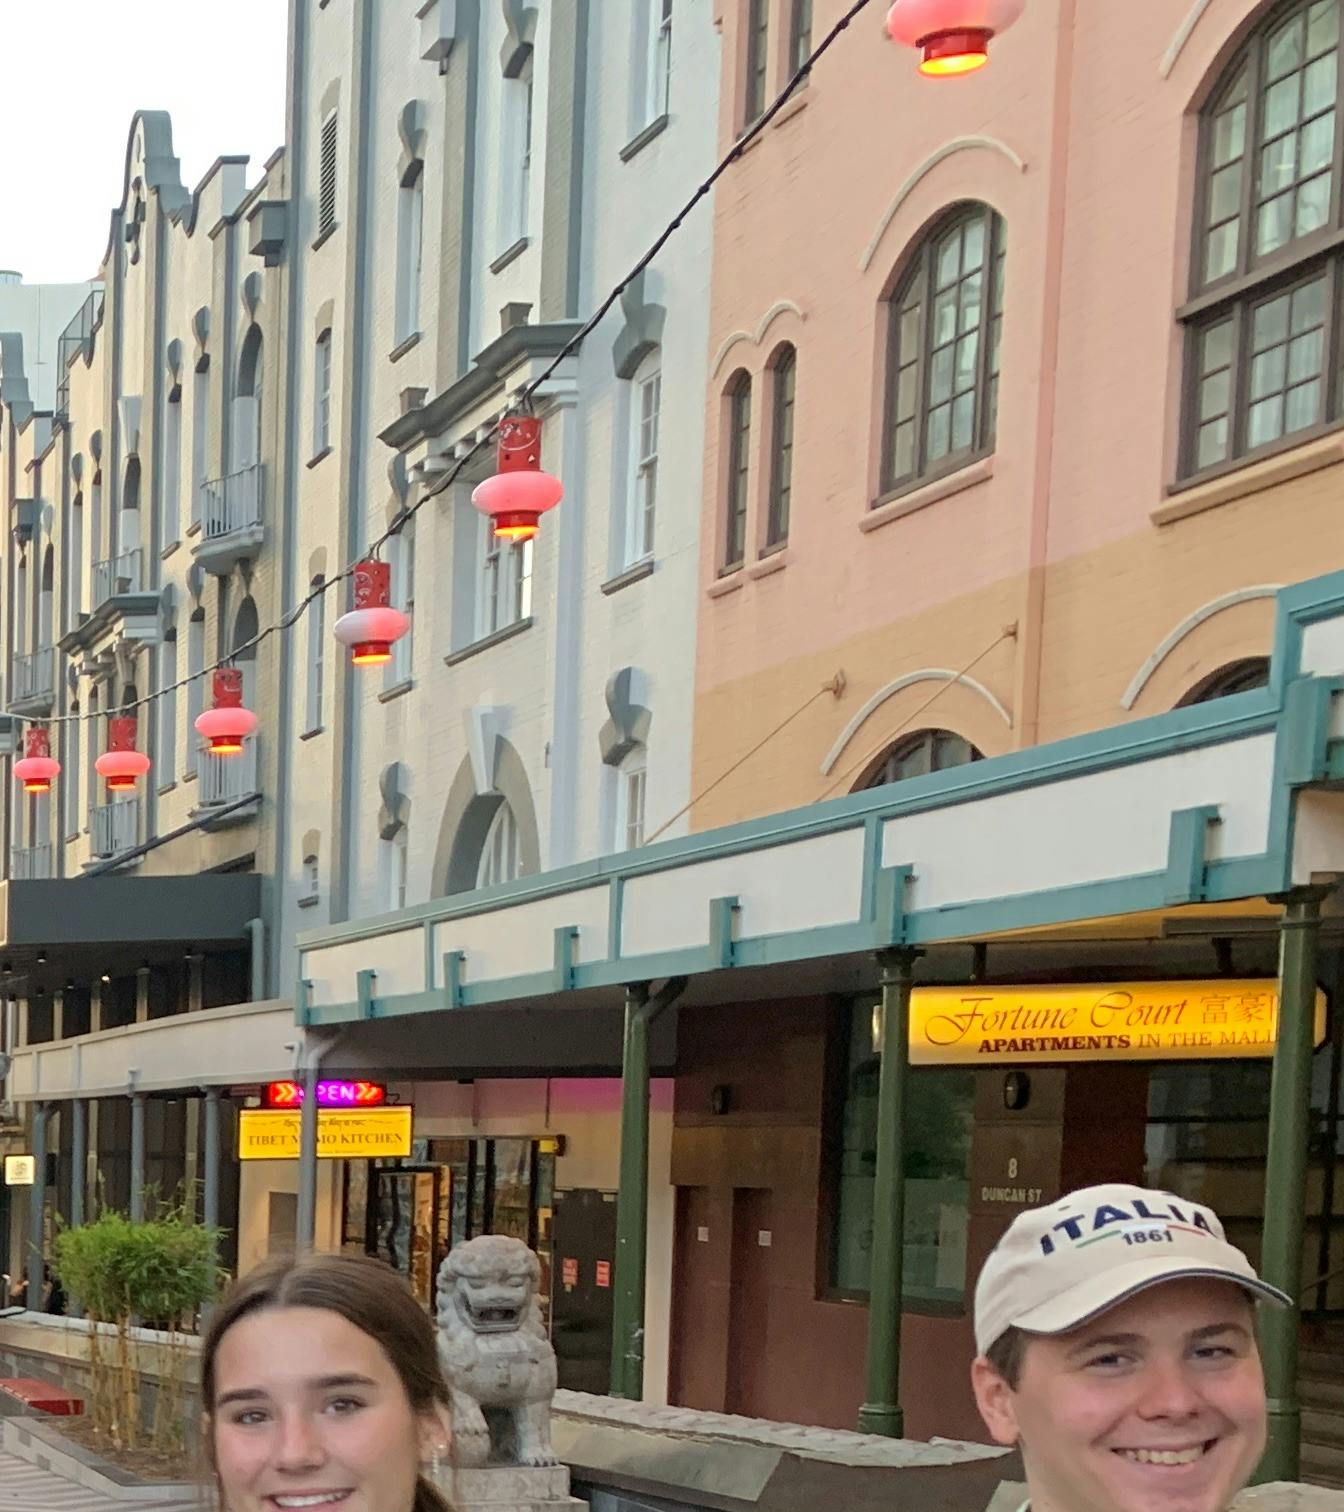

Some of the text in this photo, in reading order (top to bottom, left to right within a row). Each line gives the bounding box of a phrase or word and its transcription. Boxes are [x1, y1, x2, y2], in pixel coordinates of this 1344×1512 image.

[924, 997, 1078, 1045] Fortune
[1090, 991, 1188, 1027] Court
[978, 1035, 1131, 1053] APARTMENTS
[1138, 1033, 1160, 1048] IN
[1168, 1031, 1212, 1047] THE
[249, 1134, 286, 1146] TIBET
[341, 1132, 403, 1145] KITCHEN
[1008, 1158, 1018, 1179] 8
[981, 1186, 1042, 1203] DUNCAN ST
[1039, 1199, 1217, 1256] ITALIA
[1122, 1229, 1173, 1246] 1861
